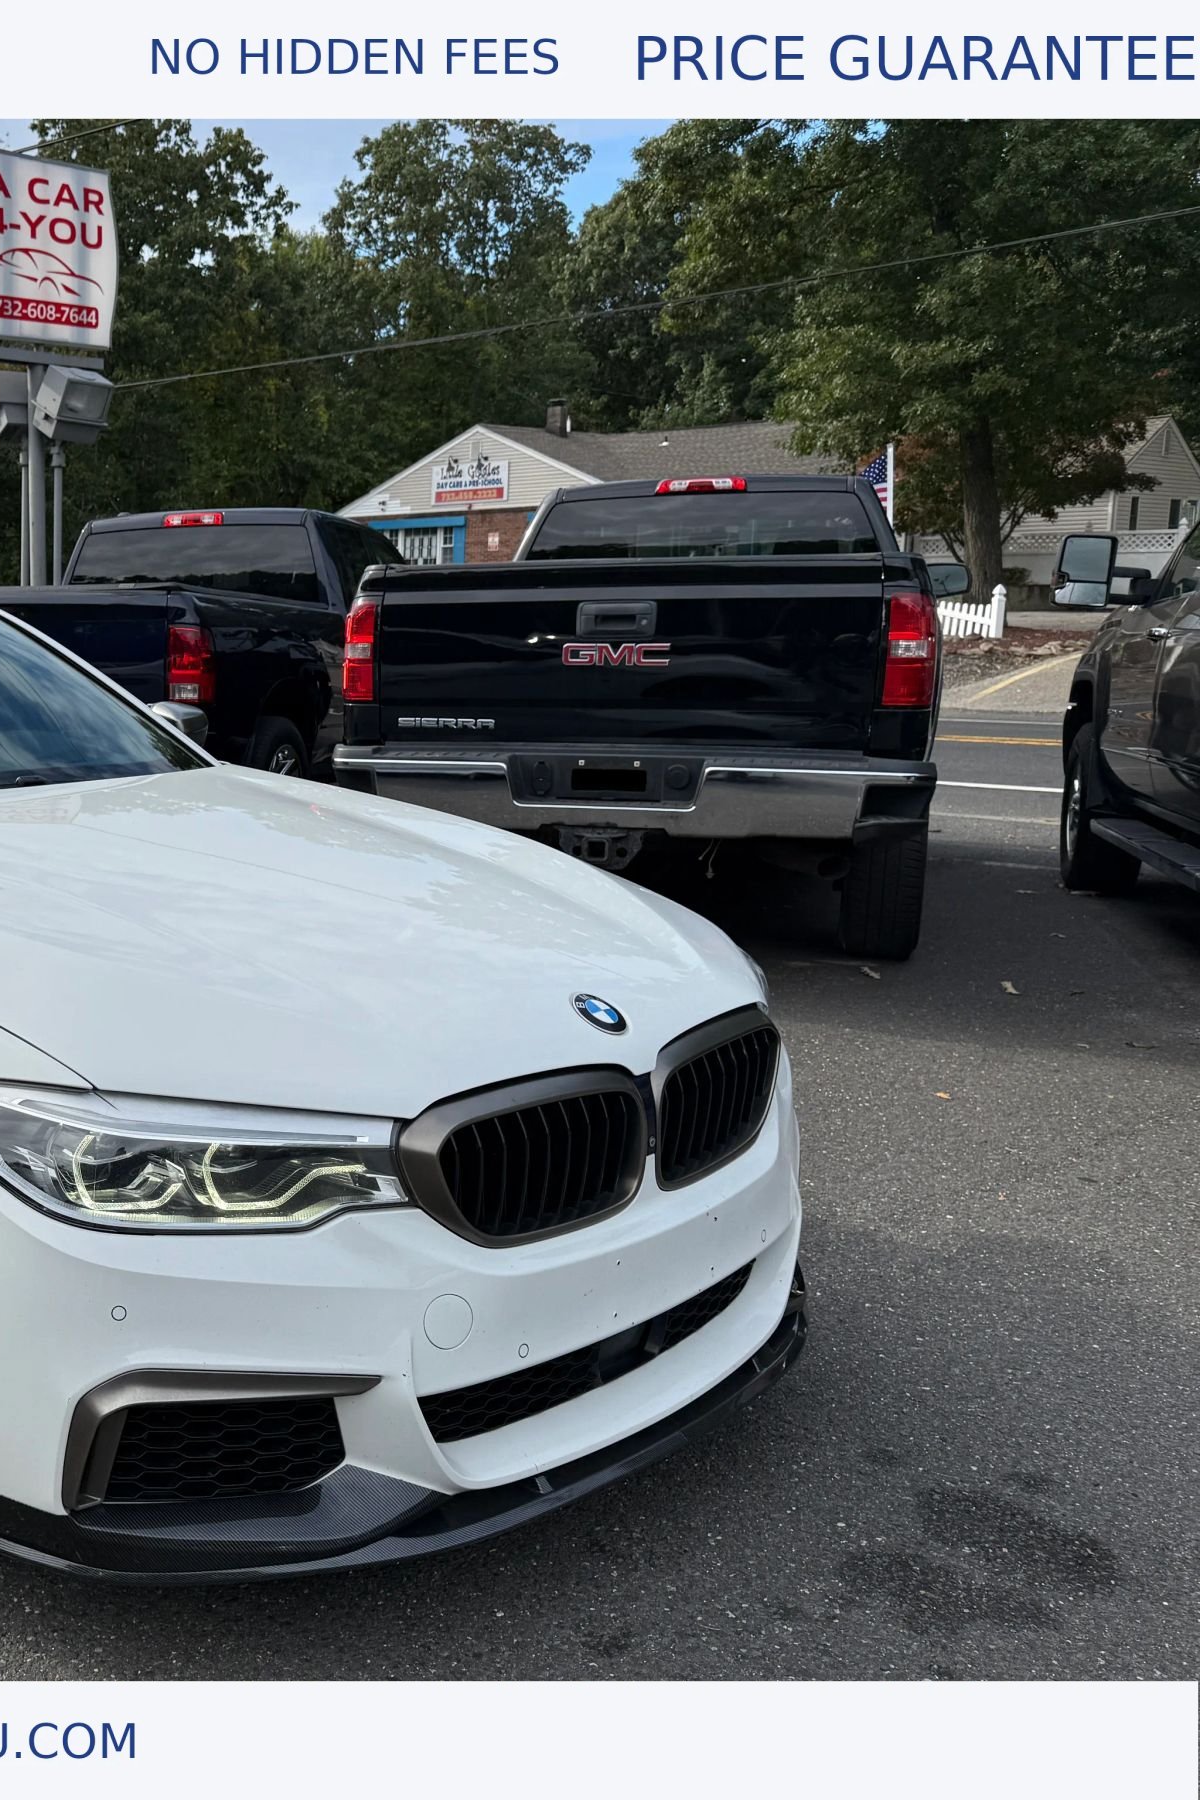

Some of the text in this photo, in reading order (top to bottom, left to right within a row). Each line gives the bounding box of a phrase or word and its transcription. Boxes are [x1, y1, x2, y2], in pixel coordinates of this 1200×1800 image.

[28, 177, 104, 216] CAR
[562, 643, 671, 666] GMC
[398, 717, 495, 729] SIERRA
